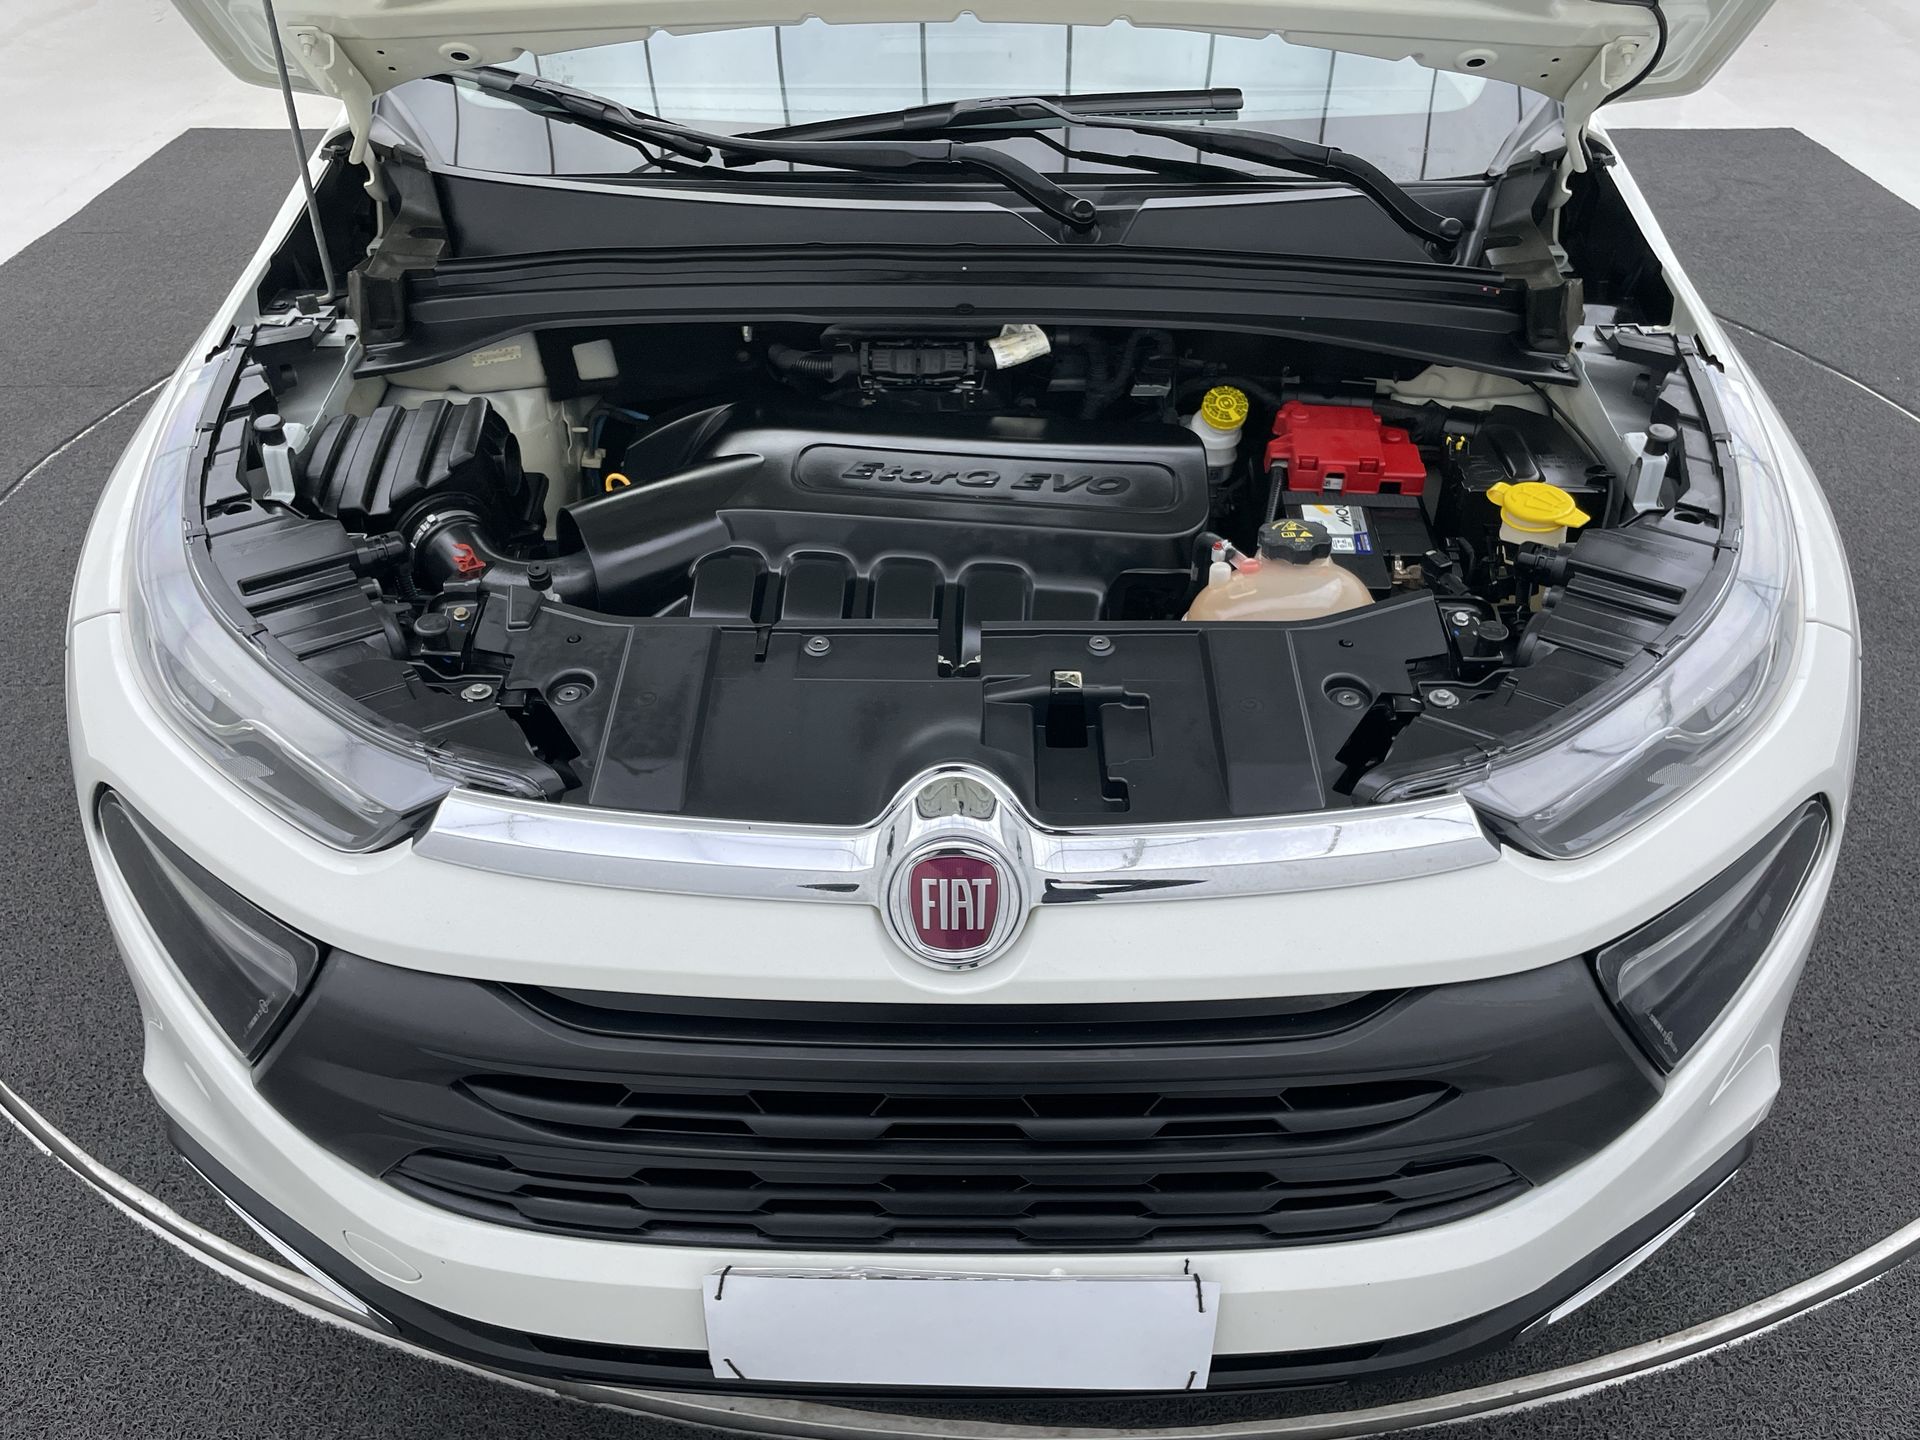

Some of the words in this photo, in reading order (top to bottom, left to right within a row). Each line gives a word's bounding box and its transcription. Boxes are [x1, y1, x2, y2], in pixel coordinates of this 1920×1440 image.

[842, 462, 1000, 488] EtorQ
[1010, 472, 1131, 495] EVO
[921, 878, 992, 930] FIAT
